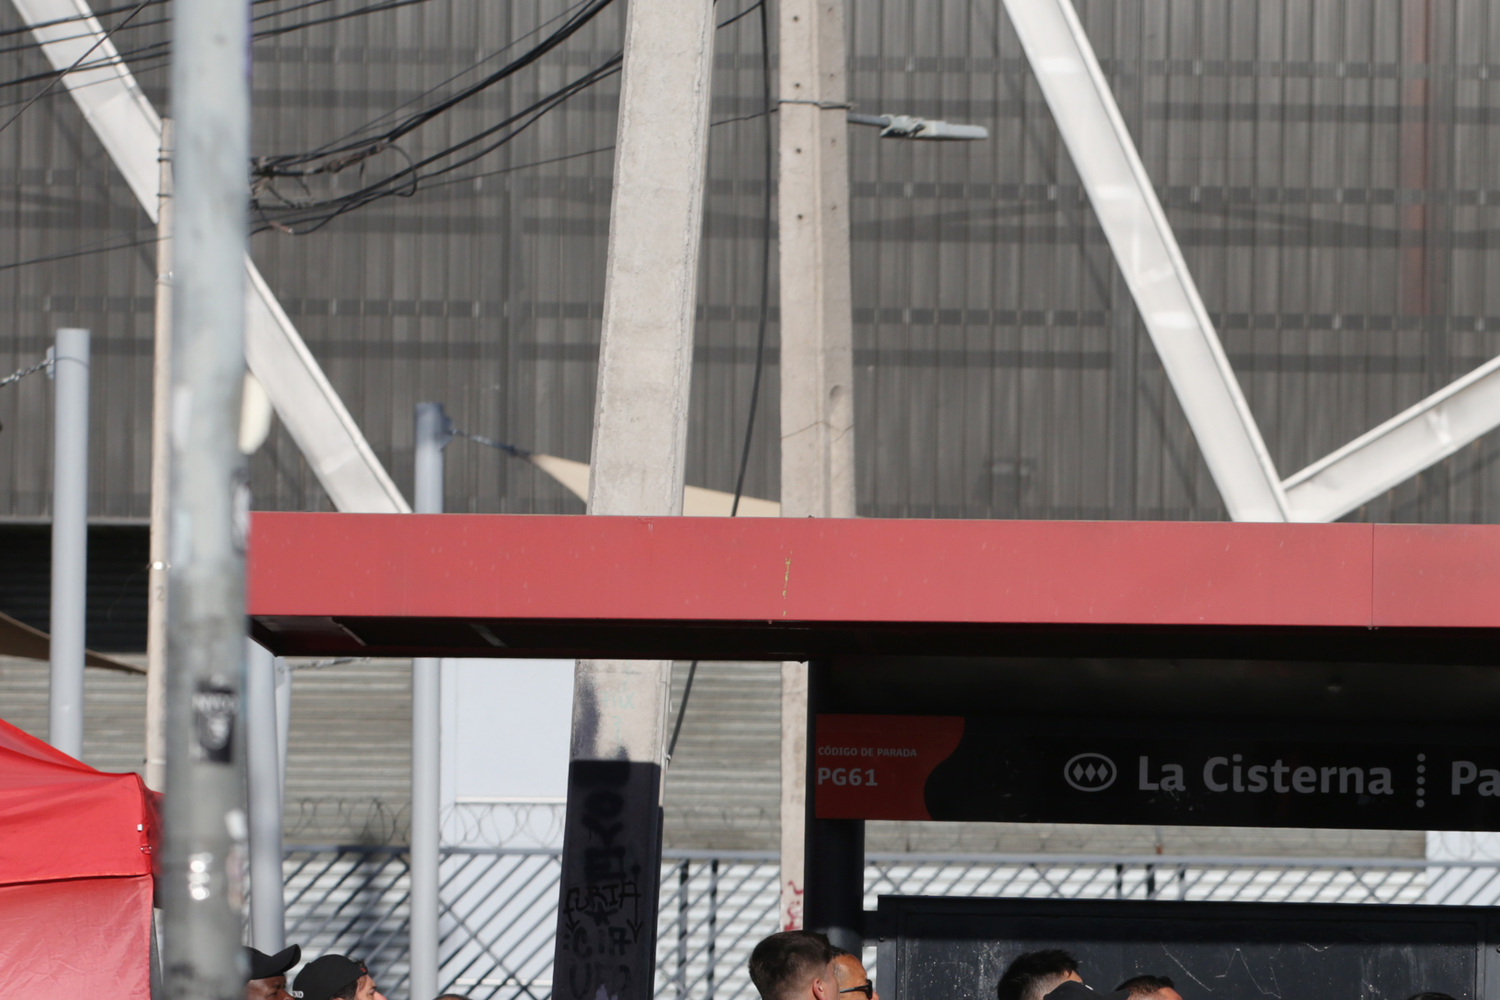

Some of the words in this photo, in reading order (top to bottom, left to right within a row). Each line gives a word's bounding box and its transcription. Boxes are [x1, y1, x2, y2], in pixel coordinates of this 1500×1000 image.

[818, 744, 858, 757] CÓDIGO
[860, 747, 875, 757] DE
[877, 748, 918, 758] PARADA
[817, 767, 879, 787] PG61
[1138, 755, 1186, 792] La
[1202, 753, 1395, 796] Cisterna
